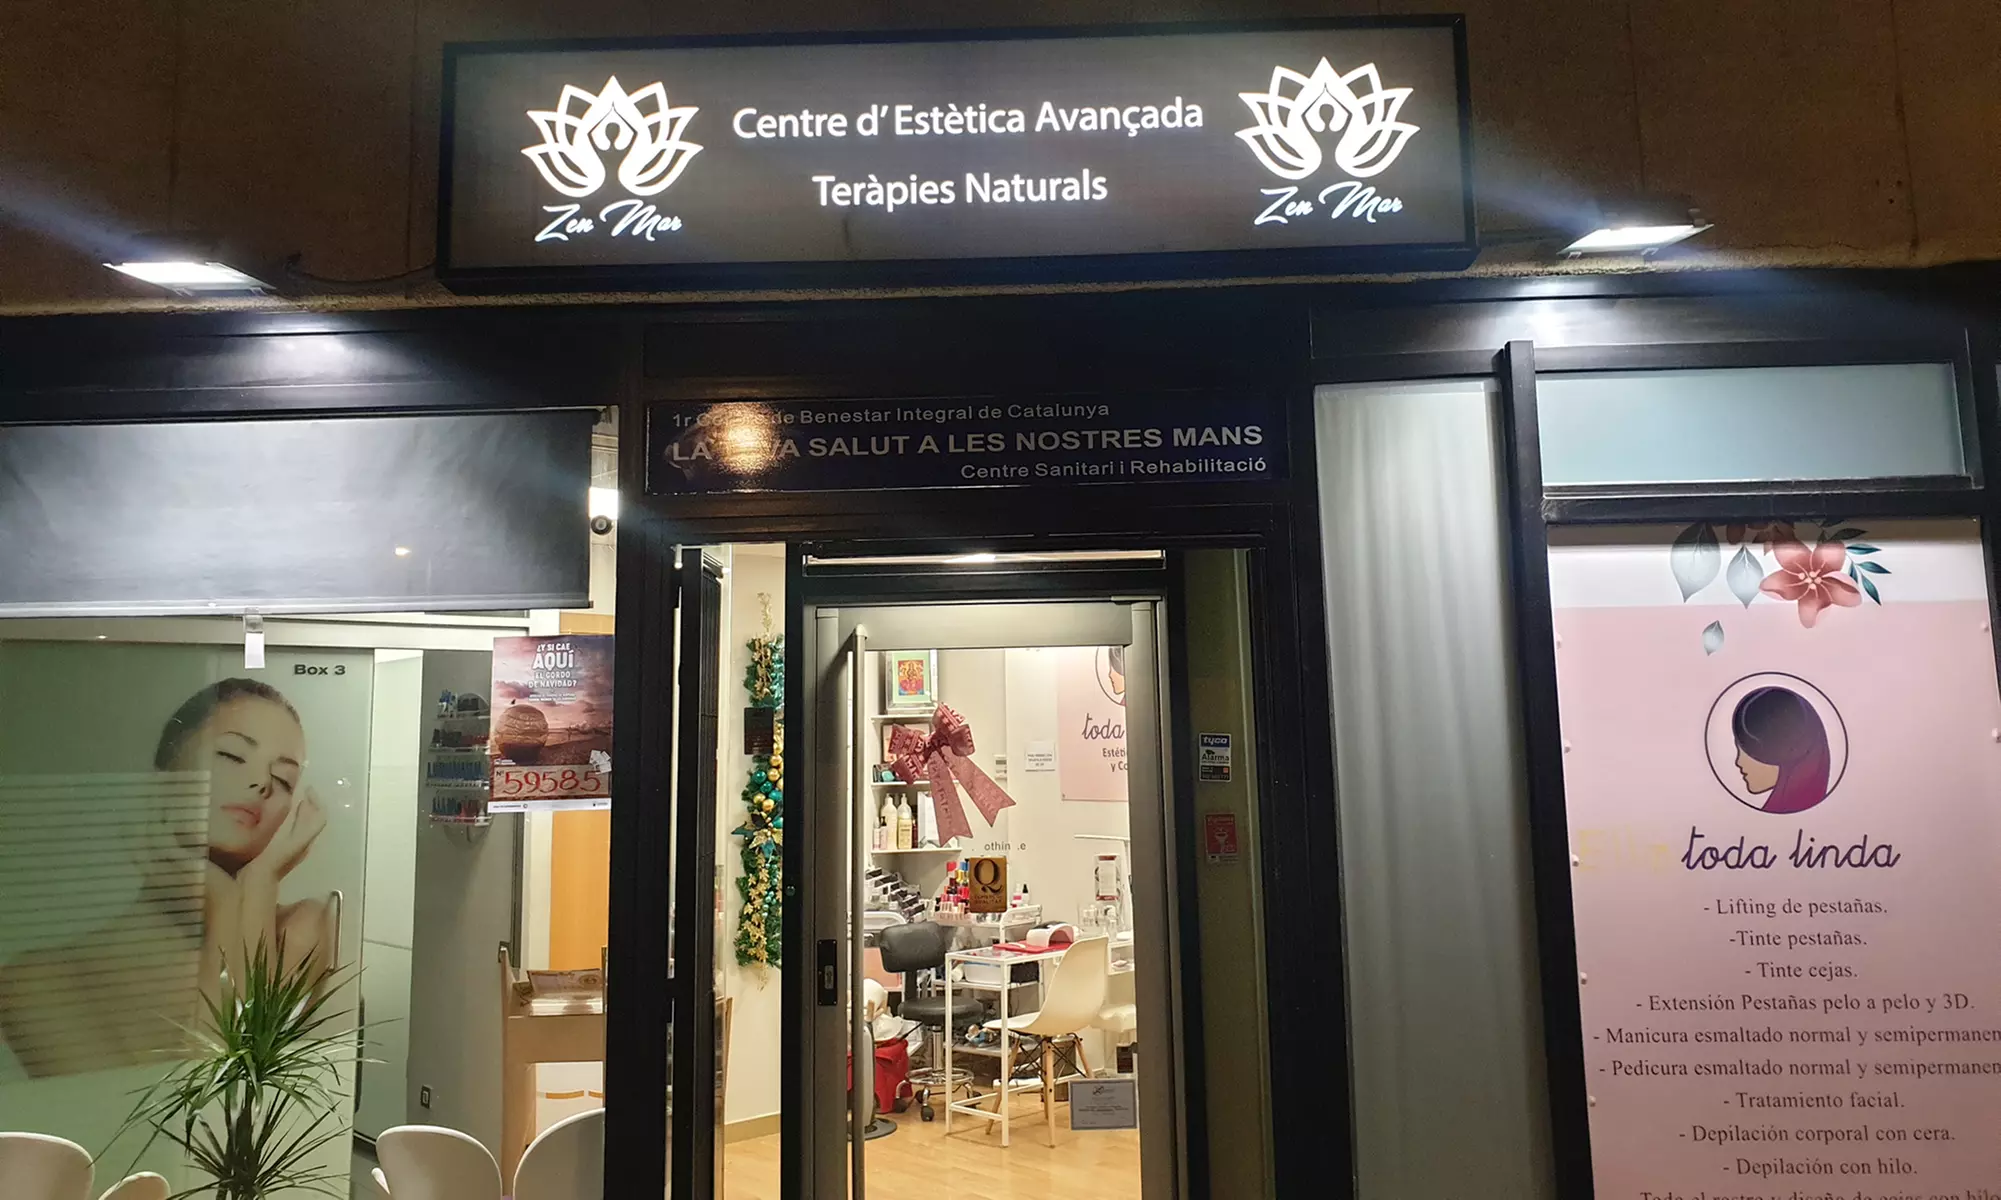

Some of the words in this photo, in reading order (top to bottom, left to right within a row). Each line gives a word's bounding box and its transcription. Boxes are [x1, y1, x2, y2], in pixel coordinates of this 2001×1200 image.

[733, 107, 848, 139] Centre
[895, 103, 1025, 135] Estètica
[1034, 96, 1203, 137] Avançada
[811, 174, 956, 213] Teràpies
[966, 168, 1108, 203] Naturals
[1253, 186, 1313, 225] Zen
[1318, 180, 1403, 223] Mar
[534, 203, 594, 242] Zen
[599, 199, 682, 241] Mar
[672, 414, 692, 428] 1r
[771, 410, 795, 425] de
[799, 408, 892, 425] Benestar
[896, 405, 973, 424] Integral
[978, 405, 1002, 419] de
[1007, 403, 1110, 420] Catalunya
[672, 441, 713, 461] LA
[808, 435, 910, 457] SALUT
[917, 435, 940, 454] A
[948, 431, 1006, 453] LES
[1015, 428, 1163, 451] NOSTRES
[1172, 425, 1263, 448] MANS
[960, 463, 1029, 479] Centre
[1034, 461, 1115, 477] Sanitari
[1120, 461, 1124, 475] i
[1130, 457, 1267, 475] Rehabilitació
[547, 643, 555, 652] SI
[555, 642, 571, 652] CAE
[293, 664, 329, 676] Box
[334, 665, 346, 676] 3
[532, 649, 575, 671] AQUÍ
[1081, 712, 1125, 740] toda
[1202, 736, 1229, 746] tyco
[502, 769, 602, 795] 59585
[1681, 825, 1778, 870] toda
[1788, 828, 1901, 869] linda
[974, 858, 1003, 893] Q
[1716, 898, 1777, 919] Lifting
[1782, 897, 1803, 914] de
[1808, 898, 1888, 918] pestañas.
[1787, 930, 1867, 950] pestañas.
[1756, 961, 1803, 978] Tinte
[1808, 961, 1858, 982] cejas.
[1648, 993, 1735, 1011] Extensión
[1741, 993, 1817, 1011] Pestañas
[1823, 993, 1861, 1015] pelo
[1866, 998, 1876, 1010] a
[1882, 993, 1921, 1014] pelo
[1925, 998, 1937, 1014] y
[1943, 993, 1975, 1010] 3D.
[1606, 1026, 1689, 1044] Manicura
[1694, 1026, 1783, 1043] esmaltado
[1789, 1026, 1851, 1043] normal
[1857, 1031, 1867, 1047] y
[1611, 1059, 1688, 1077] Pedicura
[1693, 1058, 1783, 1076] esmaltado
[1789, 1058, 1851, 1076] normal
[1856, 1062, 1868, 1080] y
[1735, 1091, 1843, 1108] Tratamiento
[1850, 1091, 1905, 1108] facial.
[1692, 1124, 1789, 1146] Depilación
[1795, 1124, 1869, 1146] corporal
[1875, 1129, 1907, 1141] con
[1912, 1128, 1955, 1141] cera.
[1736, 1157, 1834, 1179] Depilación
[1839, 1162, 1872, 1175] con
[1877, 1157, 1918, 1175] hilo.
